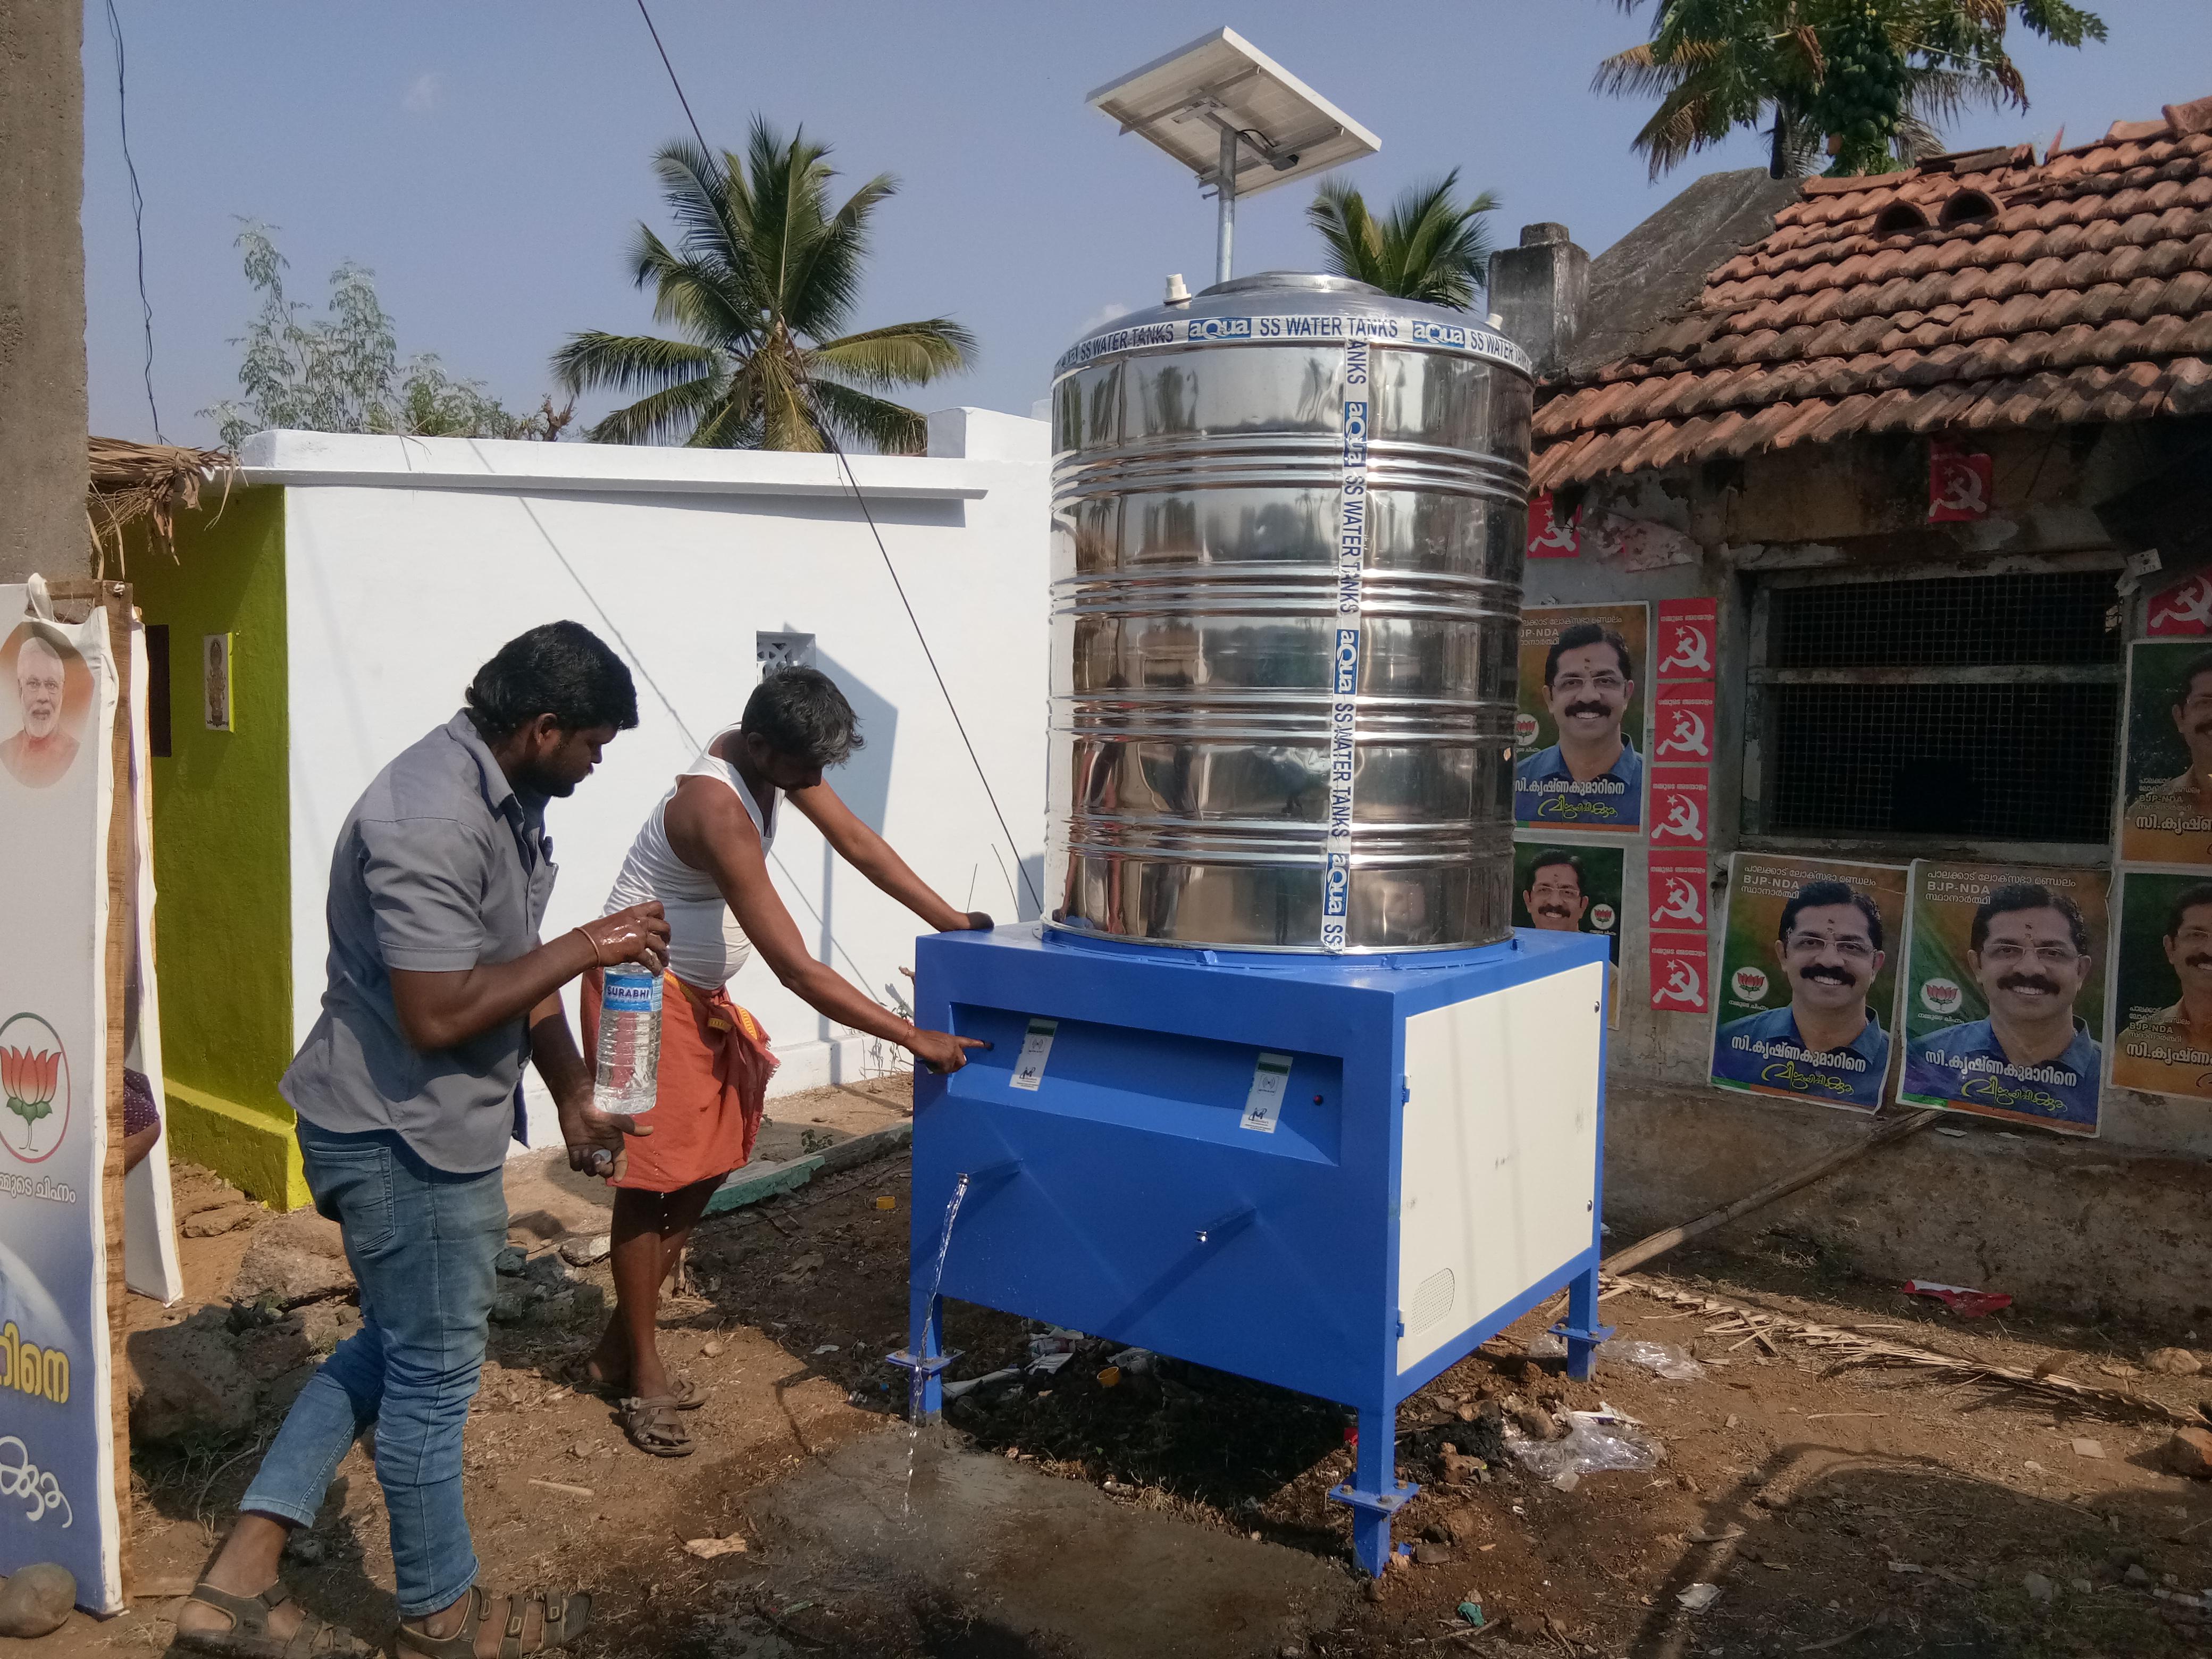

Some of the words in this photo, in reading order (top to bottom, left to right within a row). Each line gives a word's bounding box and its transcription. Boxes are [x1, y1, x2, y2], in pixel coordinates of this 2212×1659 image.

[1081, 343, 1091, 361] SS
[1093, 331, 1128, 355] WATER
[1260, 318, 1280, 337] SS
[1286, 317, 1343, 336] WATER
[1347, 317, 1398, 337] TANKS
[1471, 331, 1484, 351] SS
[1485, 334, 1514, 362] WATER
[1347, 340, 1367, 385] ANKS
[1344, 475, 1364, 496] SS
[1342, 500, 1363, 556] WATER
[1339, 561, 1361, 614] TANKS
[1520, 628, 1559, 638] JP-NDA
[1335, 703, 1354, 723] SS
[1333, 727, 1353, 781] WATER
[1331, 787, 1351, 838] TANKS
[1744, 865, 1789, 876] പാലക്കാട്
[1928, 870, 1976, 881] പാലക്കാട്
[1743, 874, 1799, 890] BJP-NDA
[1926, 881, 1991, 895] BJP-NDA
[1323, 924, 1343, 945] SS
[607, 986, 649, 999] SURABHI
[2129, 1022, 2174, 1034] BJP-NDA
